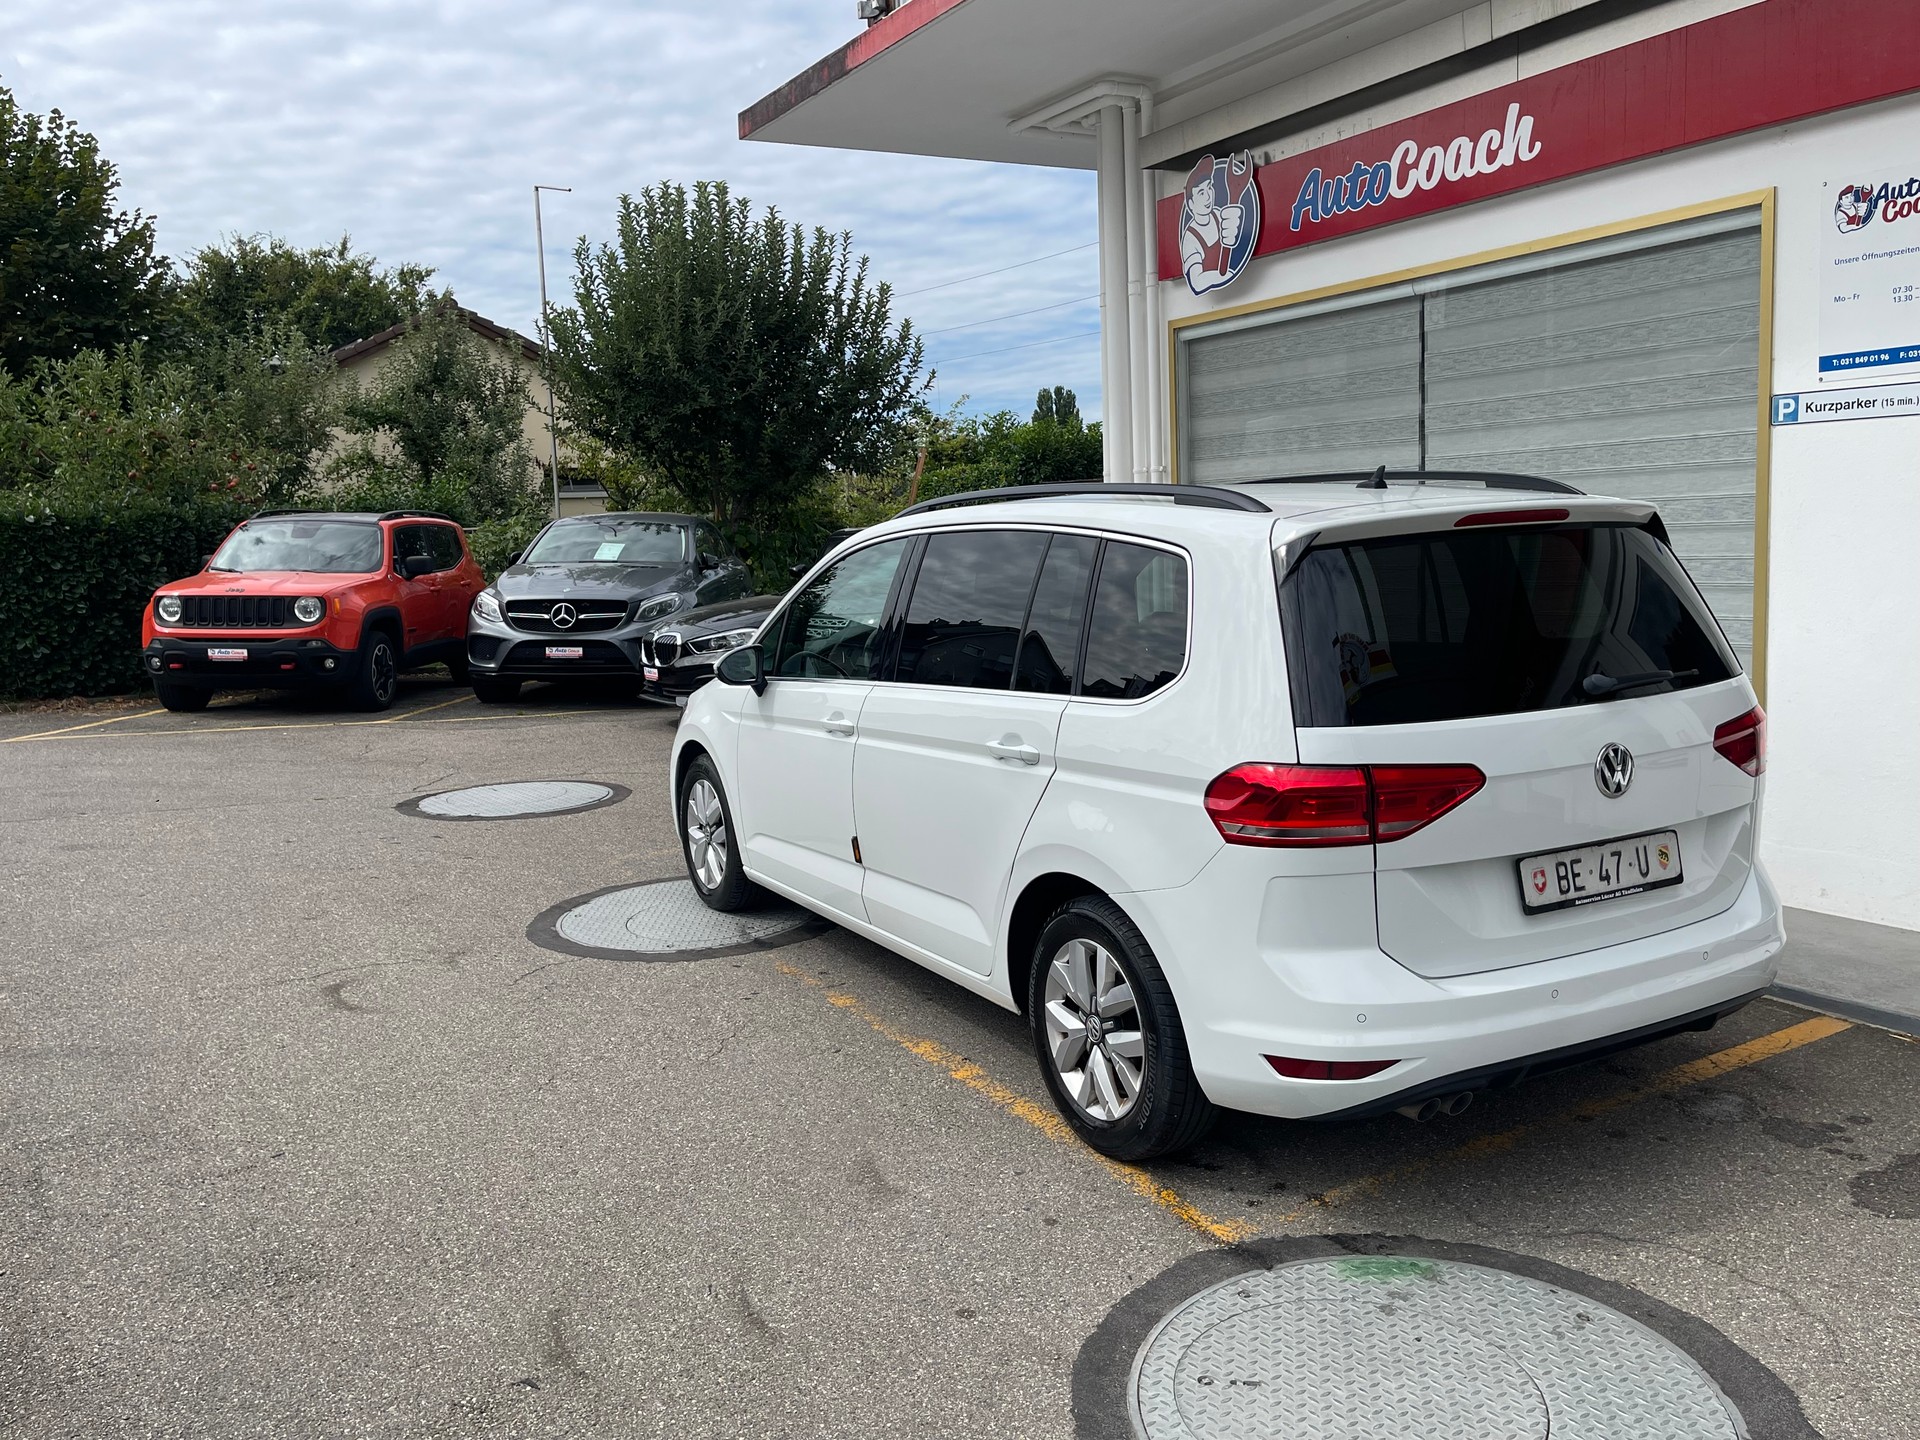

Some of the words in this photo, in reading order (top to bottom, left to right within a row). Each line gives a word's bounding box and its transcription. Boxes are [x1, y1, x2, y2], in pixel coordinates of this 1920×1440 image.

[1834, 256, 1860, 266] Unsere
[1861, 246, 1920, 261] Öffnungszeiten
[1892, 285, 1913, 295] 07.30
[1833, 295, 1846, 303] Mo
[1852, 293, 1860, 301] Fr
[1893, 294, 1913, 303] 13.30
[1832, 359, 1839, 367] T:
[1840, 357, 1853, 366] 031
[1855, 355, 1868, 364] 849
[1869, 354, 1878, 362] 01
[1880, 353, 1890, 361] 96
[1778, 398, 1796, 422] P
[1805, 398, 1878, 414] Kurzparker
[1881, 397, 1895, 409] (15
[1897, 395, 1920, 407] min.)
